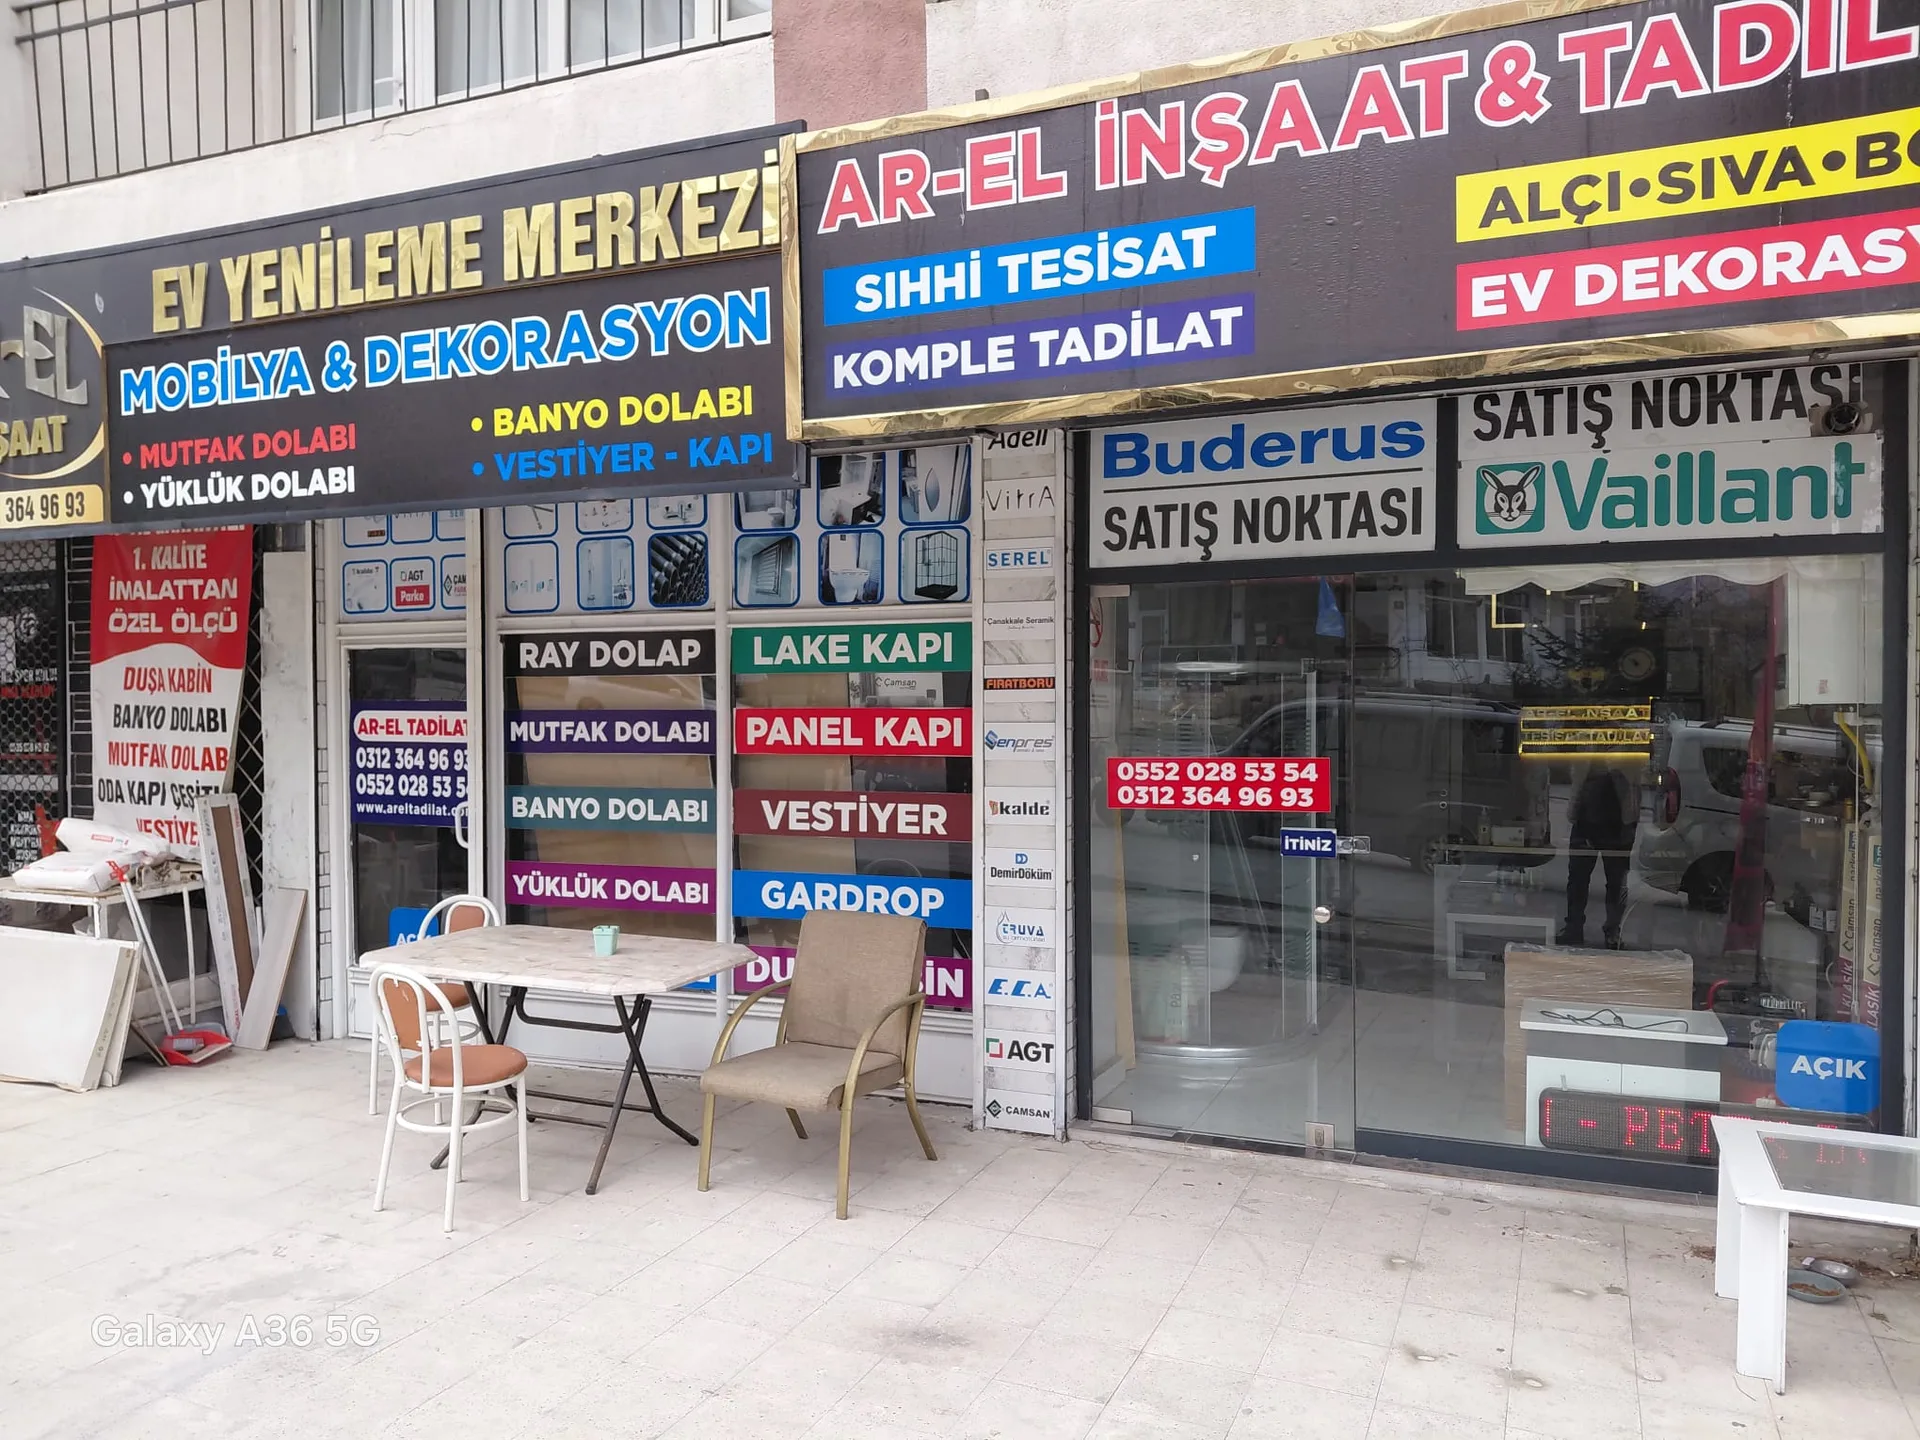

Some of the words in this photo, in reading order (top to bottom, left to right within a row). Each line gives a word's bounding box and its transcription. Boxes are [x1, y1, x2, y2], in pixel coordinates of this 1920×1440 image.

[817, 126, 1068, 234] AR-EL
[1094, 50, 1469, 191] İNŞAAT
[1474, 40, 1552, 127] &
[153, 262, 209, 333] EV
[219, 215, 483, 323] YENİLEME
[503, 148, 781, 282] MERKEZİ
[854, 250, 982, 312] SIHHİ
[998, 225, 1217, 295] TESİSAT
[1471, 268, 1554, 317] EV
[120, 345, 315, 416] MOBİLYA
[321, 340, 357, 393] &
[364, 286, 771, 387] DEKORASYON
[833, 334, 1015, 389] KOMPLE
[1029, 306, 1244, 367] TADİLAT
[493, 399, 609, 437] BANYO
[619, 385, 752, 427] DOLABI
[1473, 382, 1613, 449] SATIŞ
[1631, 363, 1862, 430] NOKTASI
[139, 433, 246, 470] MUTFAK
[252, 423, 356, 458] DOLABI
[494, 440, 654, 481] VESTİYER
[689, 432, 772, 468] KAPI
[1103, 420, 1426, 478] Buderus
[140, 471, 246, 509] YÜKLÜK
[251, 466, 355, 500] DOLABI
[986, 486, 1055, 511] VitrA
[1551, 441, 1866, 531] Vaillant
[6, 492, 34, 522] 364
[40, 489, 60, 519] 96
[65, 487, 86, 517] 93
[1103, 501, 1218, 561] SATIŞ
[1233, 487, 1422, 544] NOKTASI
[133, 547, 146, 570] 1.
[151, 540, 207, 570] KALİTE
[988, 551, 1049, 567] SEREL
[109, 576, 237, 600] İMALATTAN
[108, 607, 163, 633] ÖZEL
[171, 607, 237, 638] ÖLÇÜ
[519, 640, 579, 669] RAY
[589, 639, 701, 668] DOLAP
[753, 633, 851, 666] LAKE
[862, 631, 953, 664] KAPI
[123, 666, 165, 694] DUŞA
[168, 662, 212, 693] KABİN
[986, 678, 1054, 690] FIRATBORU
[113, 704, 166, 730] BANYO
[170, 706, 227, 733] DOLABI
[357, 718, 404, 735] AR-EL
[509, 720, 608, 743] MUTFAK
[614, 720, 710, 744] DOLABI
[746, 717, 863, 746] PANEL
[875, 717, 963, 747] KAPI
[108, 741, 168, 768] MUTFAK
[356, 747, 391, 769] 0312
[394, 748, 424, 770] 364
[429, 749, 449, 771] 96
[356, 773, 395, 795] 0552
[398, 774, 428, 797] 028
[432, 776, 451, 797] 53
[1117, 762, 1180, 782] 0552
[1187, 762, 1236, 782] 028
[1244, 763, 1275, 782] 53
[1283, 763, 1318, 783] 54
[98, 778, 125, 804] ODA
[127, 779, 166, 806] KAPI
[1117, 786, 1175, 805] 0312
[1182, 786, 1231, 806] 364
[1238, 787, 1272, 807] 96
[1280, 788, 1313, 807] 93
[512, 796, 600, 821] BANYO
[608, 798, 708, 823] DOLABI
[761, 794, 948, 835] VESTİYER
[1000, 802, 1049, 815] kalde
[1284, 835, 1332, 851] İTİNİZ
[512, 870, 608, 899] YÜKLÜK
[614, 880, 709, 904] DOLABI
[990, 866, 1052, 881] DemirDöküm
[761, 880, 945, 917] GARDROP
[1007, 1040, 1054, 1063] AGT
[1790, 1055, 1867, 1081] AÇIK
